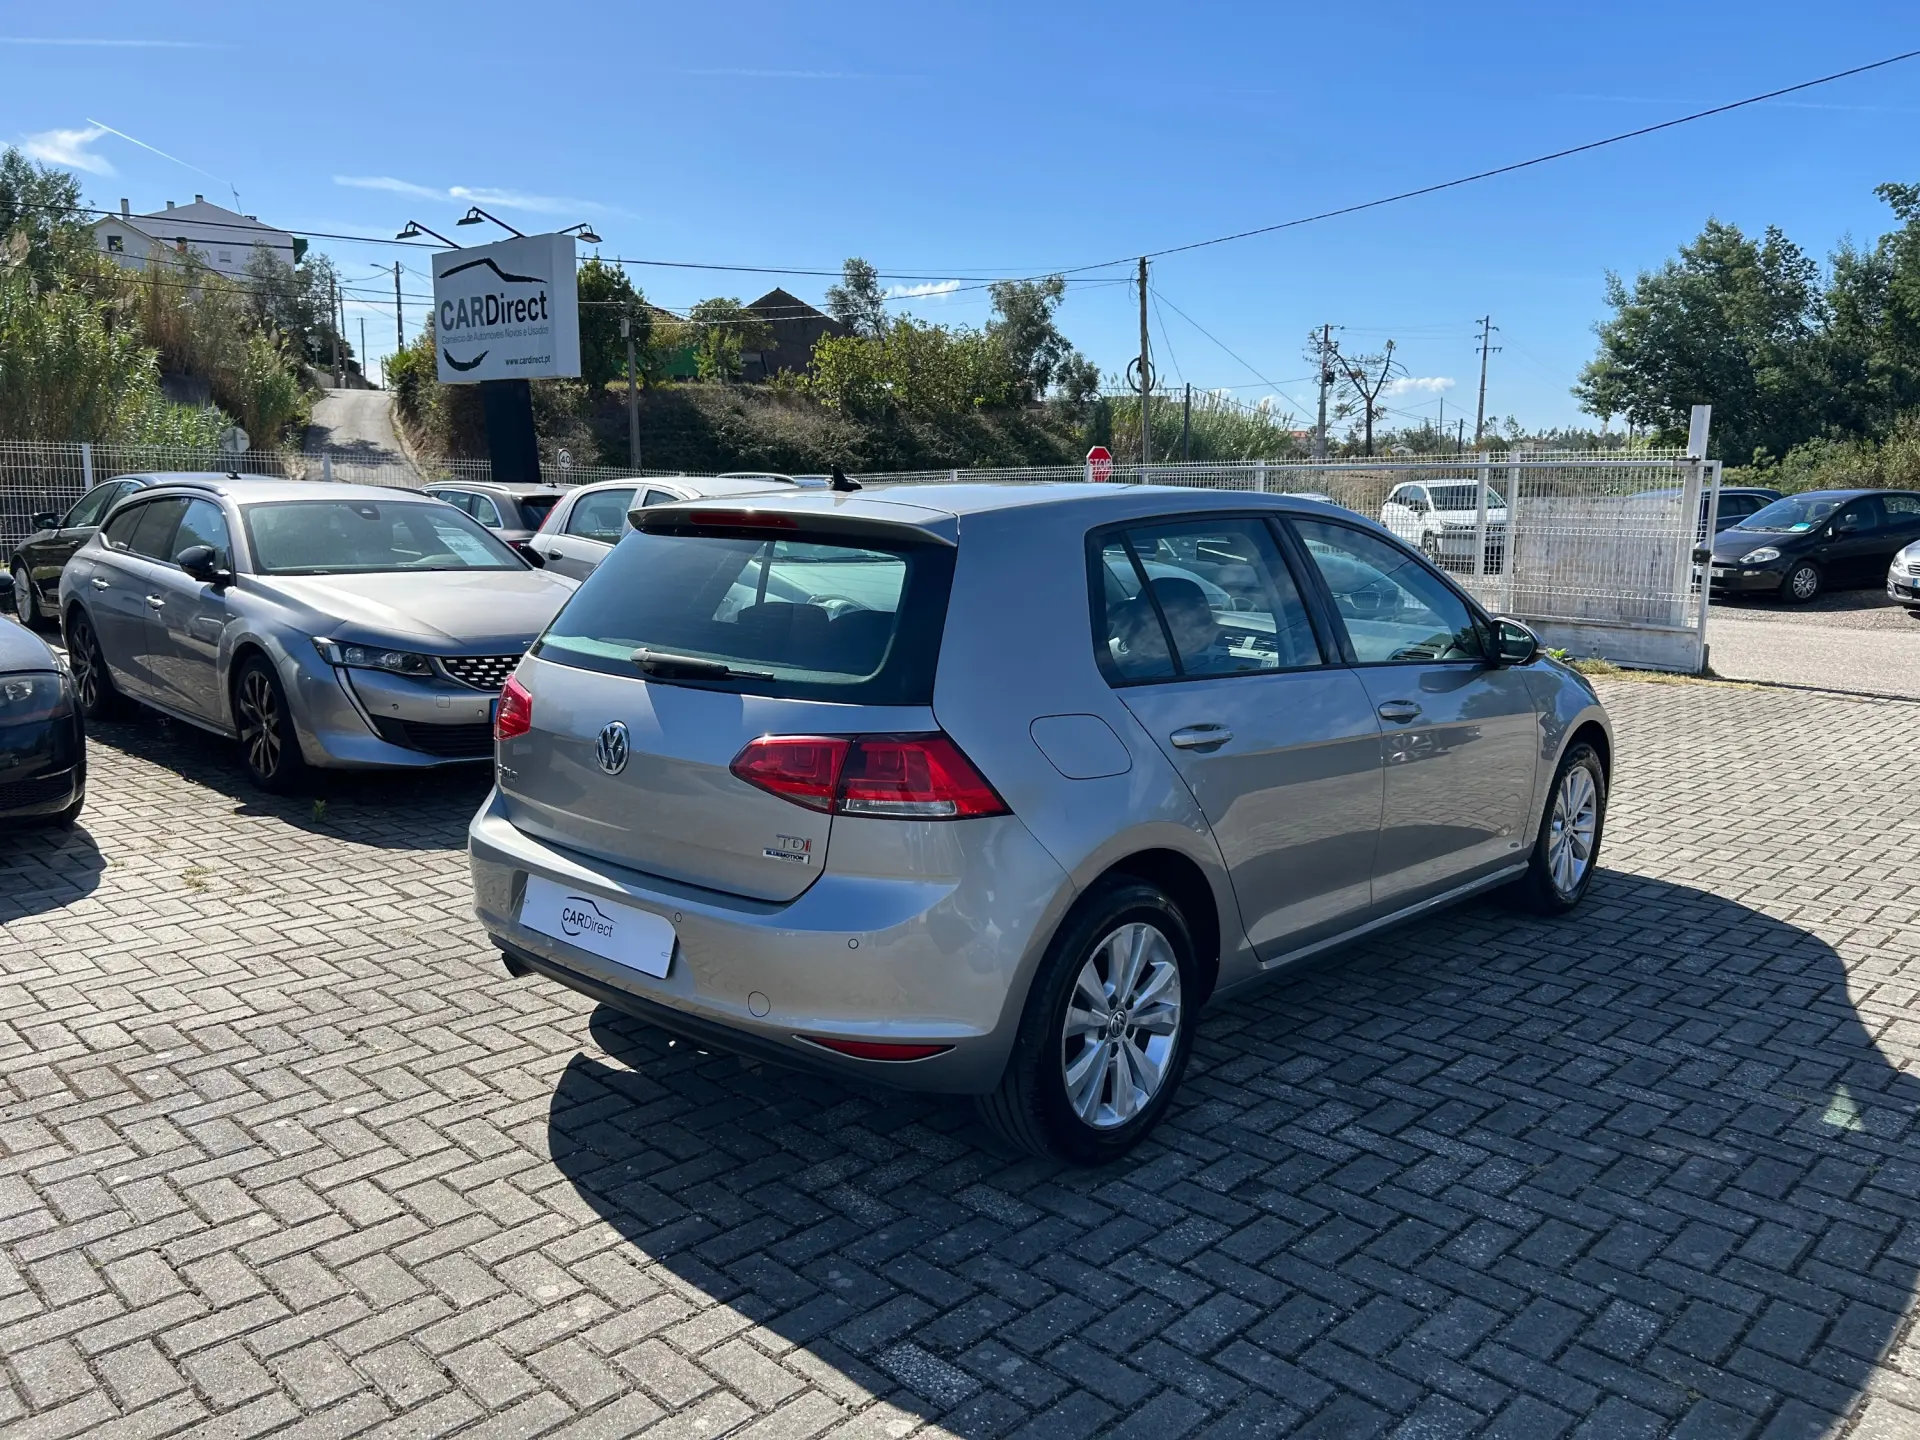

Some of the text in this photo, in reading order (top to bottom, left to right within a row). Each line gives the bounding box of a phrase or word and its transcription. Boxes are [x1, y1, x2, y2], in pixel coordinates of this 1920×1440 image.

[440, 290, 548, 331] CARDirect
[505, 328, 522, 338] Novos
[528, 325, 549, 336] Usados
[505, 354, 551, 366] www.cardirect.pt
[776, 833, 812, 852] TDI
[562, 907, 613, 938] CARDirect
